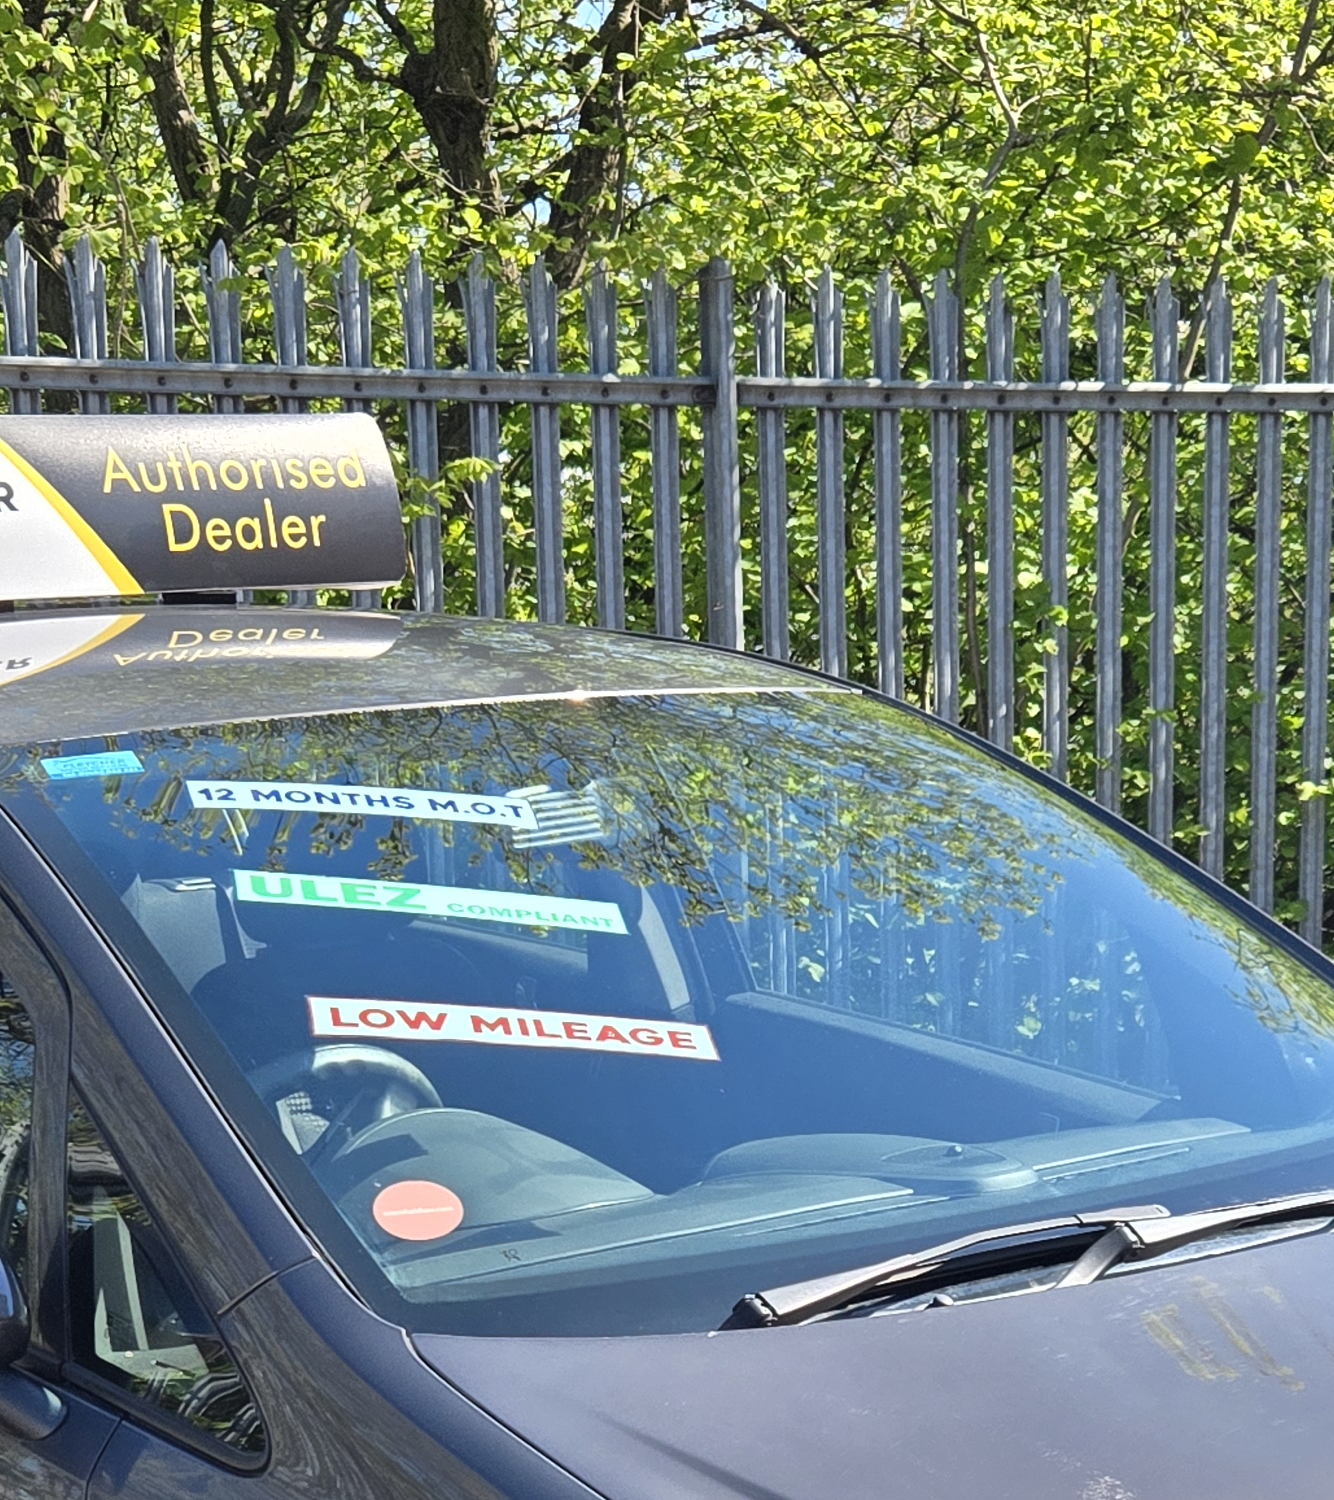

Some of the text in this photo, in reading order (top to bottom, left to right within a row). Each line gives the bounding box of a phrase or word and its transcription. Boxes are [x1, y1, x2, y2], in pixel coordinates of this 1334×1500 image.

[103, 444, 366, 493] Authorised
[162, 498, 326, 552] Dealer
[198, 788, 524, 819] 12 MONTHS M.O.T
[250, 875, 614, 929] ULEZ COMPLIANT
[330, 1006, 698, 1050] LOW MILEAGE
